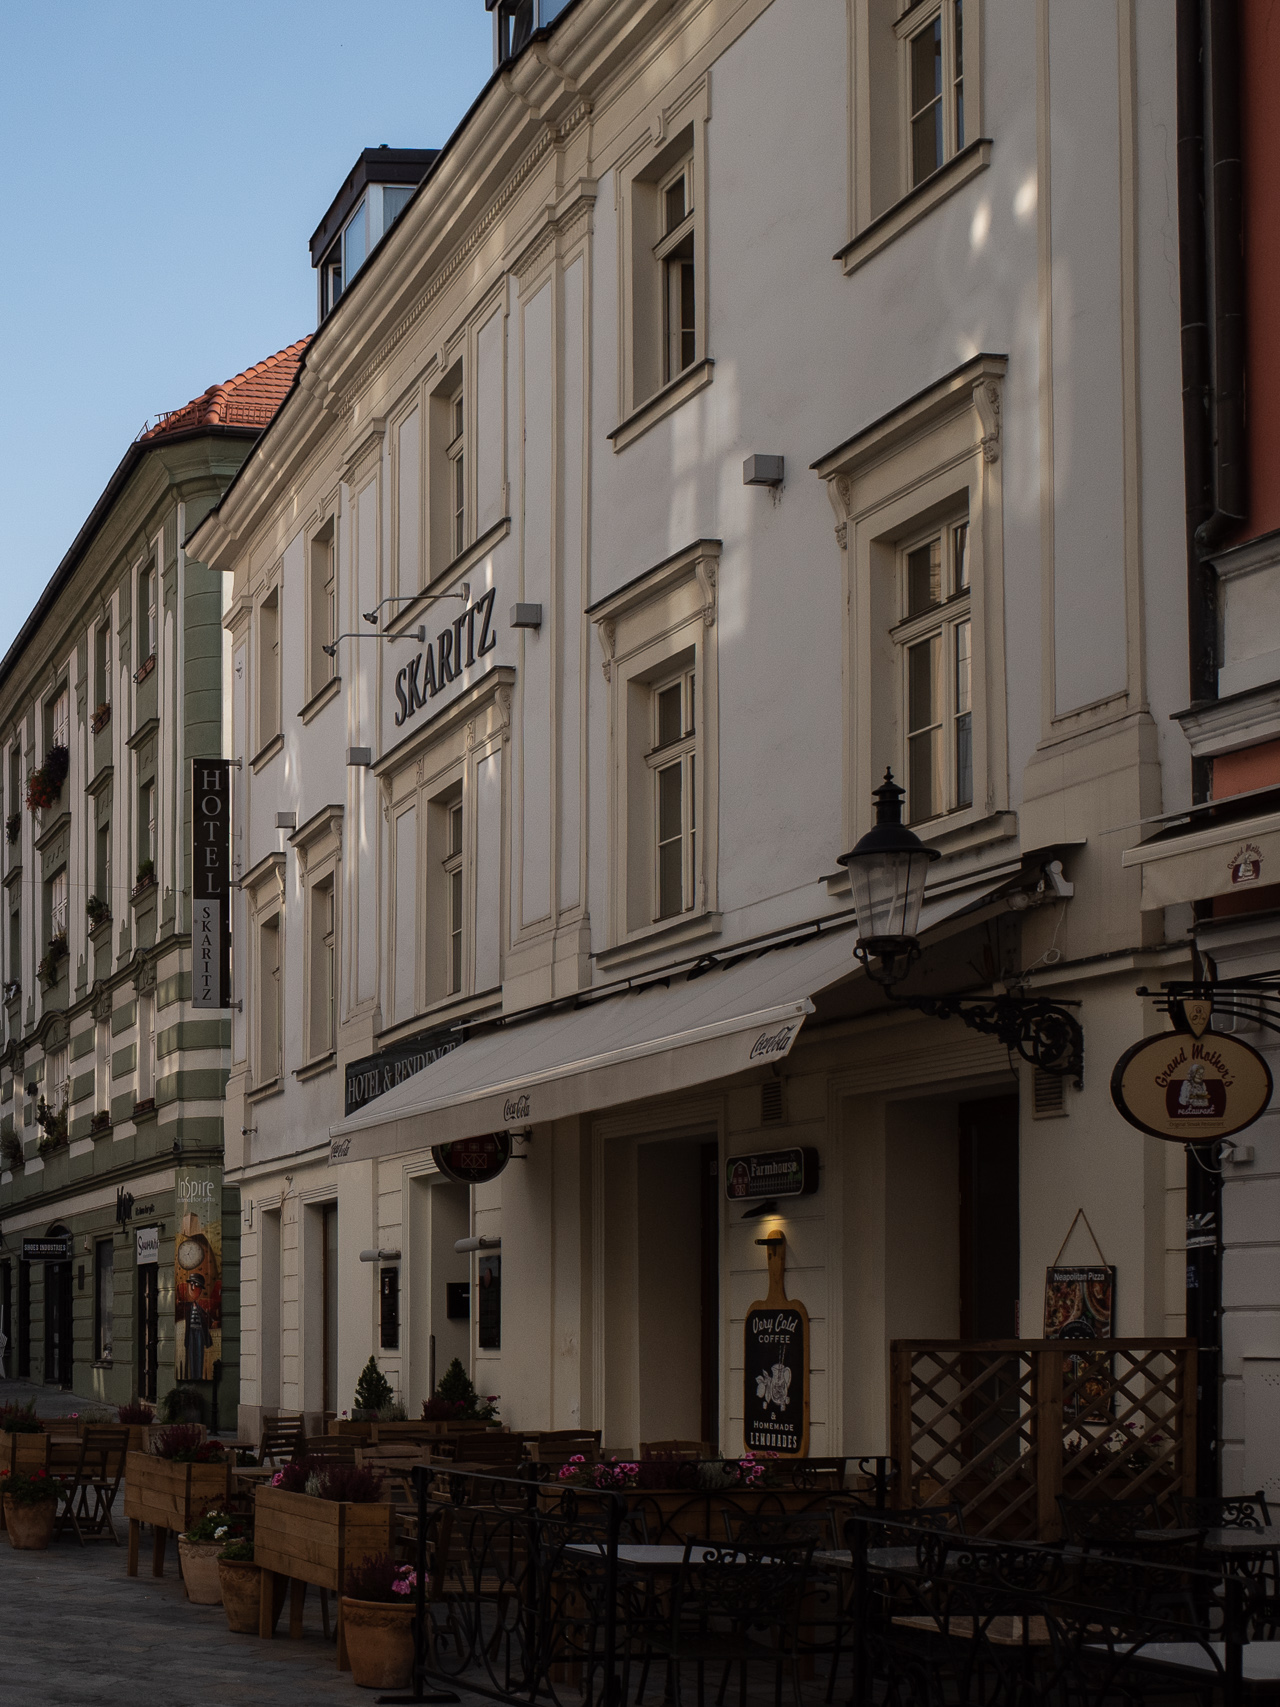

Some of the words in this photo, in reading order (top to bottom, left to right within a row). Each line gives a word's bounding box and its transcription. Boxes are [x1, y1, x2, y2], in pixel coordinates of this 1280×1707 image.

[394, 587, 496, 727] SKARITZ
[201, 769, 221, 893] HOTEL
[201, 906, 212, 1001] SKARITZ
[1155, 1047, 1187, 1088] Grand
[1192, 1043, 1236, 1088] Mother's
[348, 1069, 381, 1104] HOTEL
[383, 1065, 393, 1092] &
[1177, 1104, 1216, 1115] restaurant
[751, 1161, 797, 1177] Farmhouse
[177, 1176, 215, 1203] InSpire
[1053, 1273, 1087, 1282] Neapolitan
[1088, 1272, 1105, 1280] Pizza
[752, 1316, 773, 1334] Very
[774, 1313, 799, 1333] Cold
[758, 1335, 791, 1343] COFFEE
[770, 1411, 777, 1420] &
[750, 1432, 798, 1449] LEMONADES
